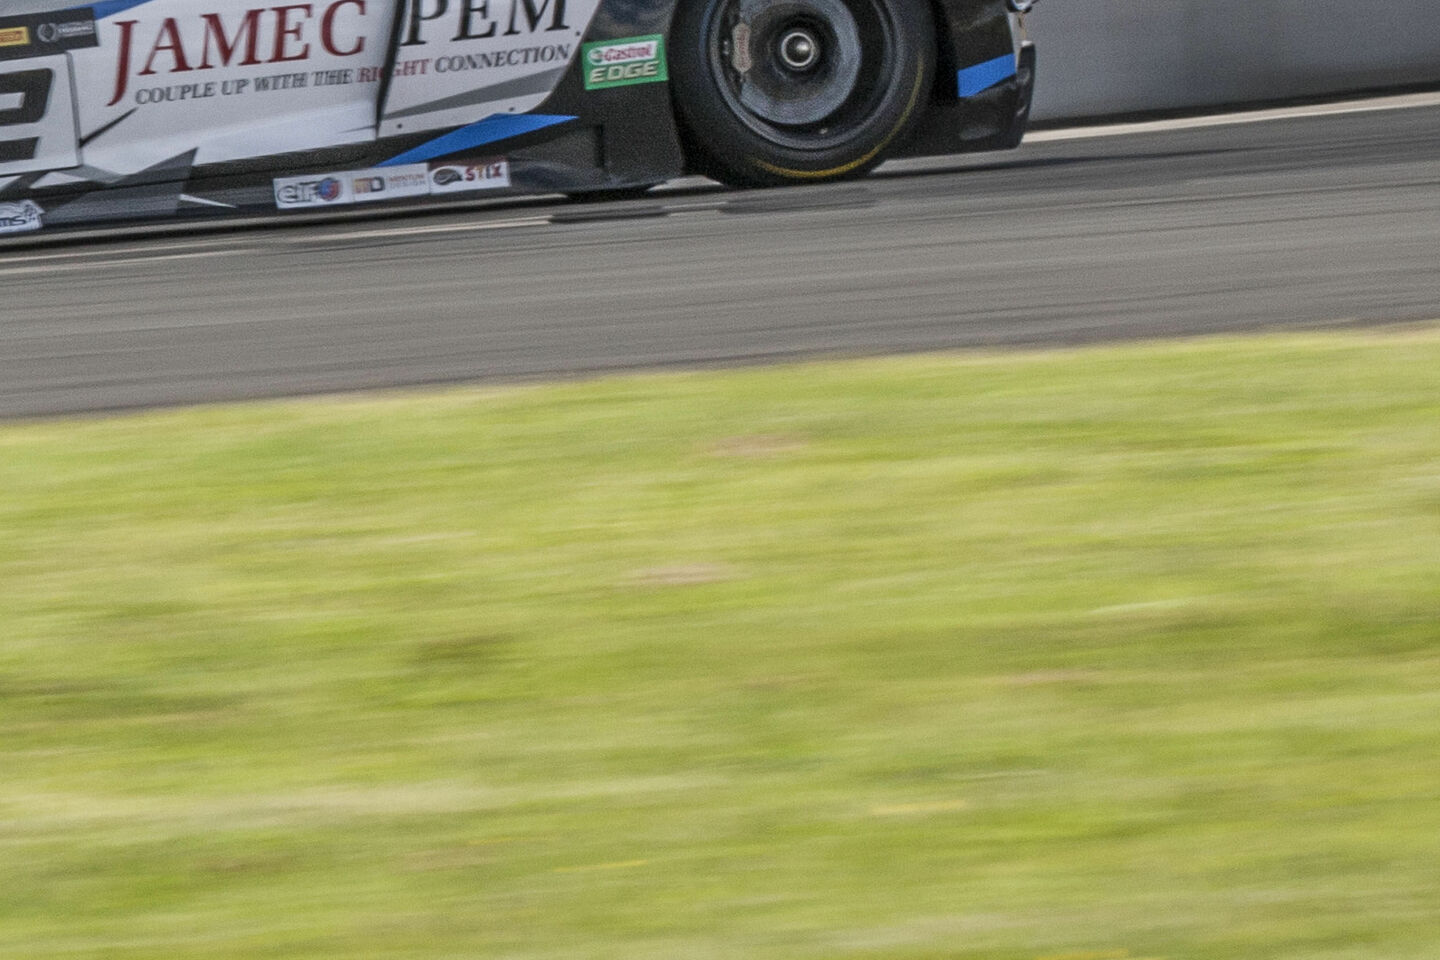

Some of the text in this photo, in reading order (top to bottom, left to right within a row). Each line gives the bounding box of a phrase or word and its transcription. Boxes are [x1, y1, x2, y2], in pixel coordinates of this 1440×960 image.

[603, 44, 652, 61] Castrol
[135, 81, 218, 104] COUPLE
[221, 78, 250, 95] UP
[254, 72, 307, 92] WITH
[311, 69, 353, 86] THE
[434, 44, 570, 73] CONNECTION
[589, 61, 659, 83] EDGE
